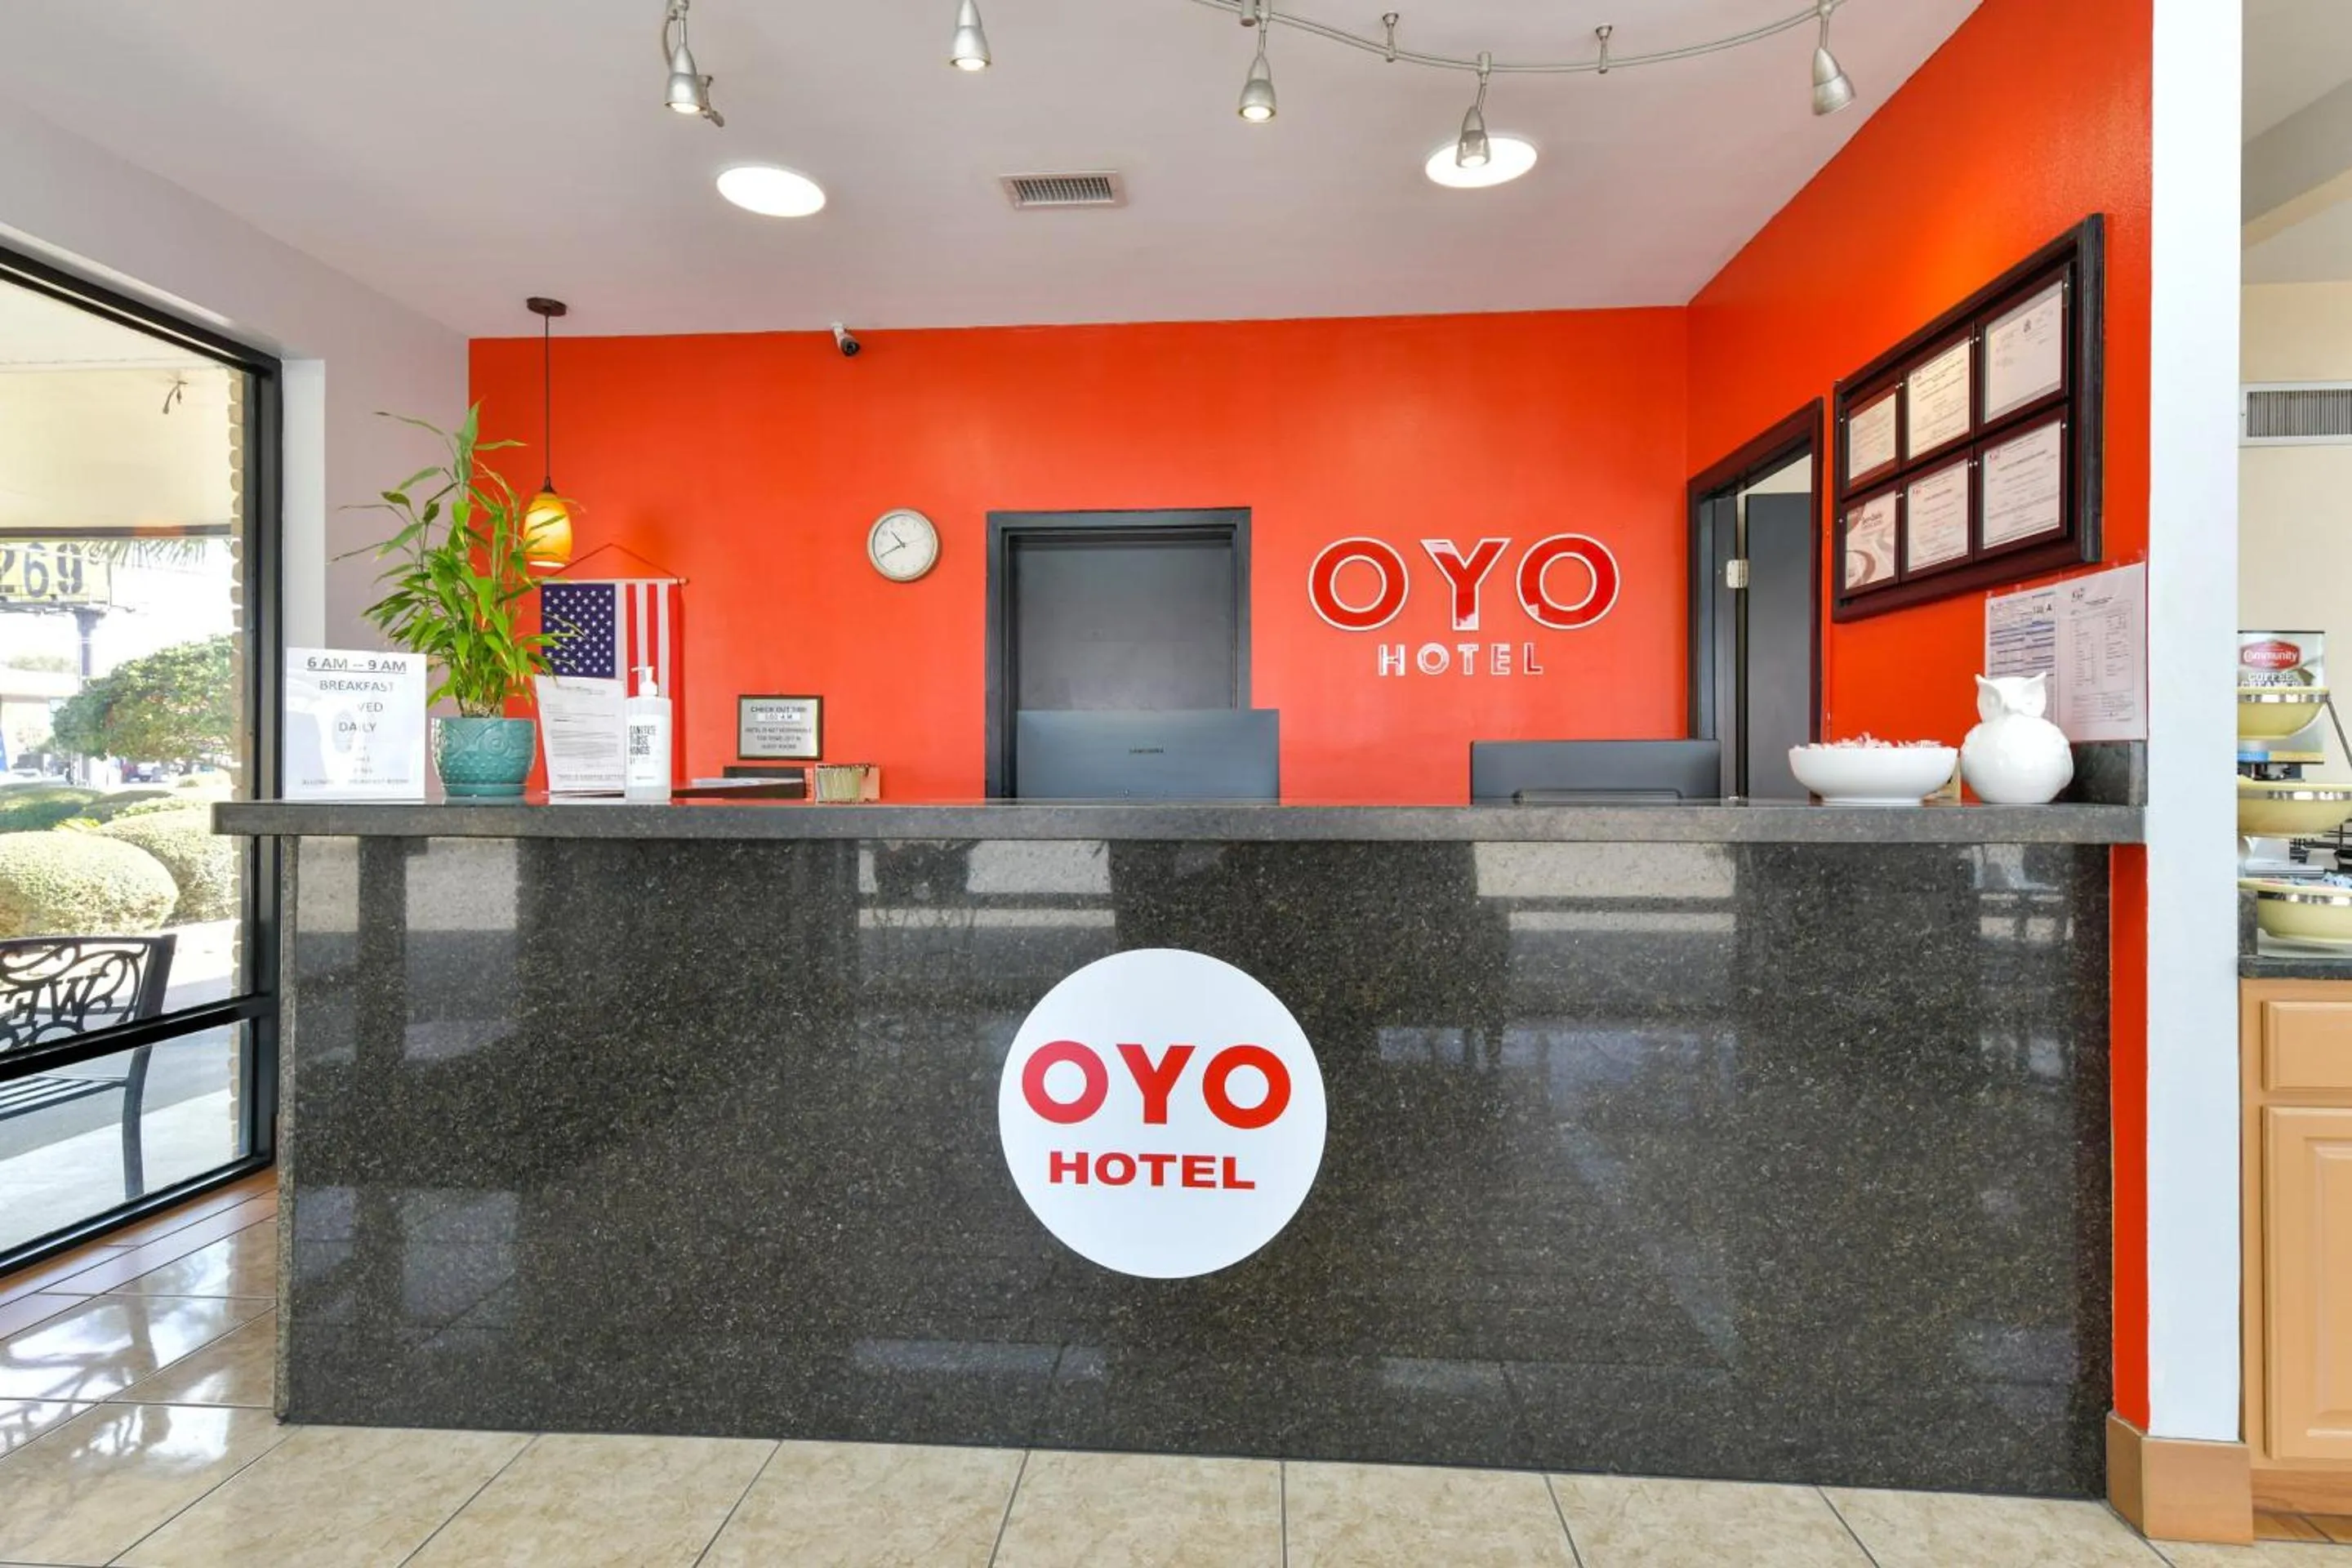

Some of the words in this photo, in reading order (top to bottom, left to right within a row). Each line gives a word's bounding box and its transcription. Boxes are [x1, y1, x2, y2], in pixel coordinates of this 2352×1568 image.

[1308, 532, 1619, 631] OYO
[306, 657, 318, 669] 6
[321, 658, 348, 670] AM
[368, 659, 377, 670] 9
[381, 661, 408, 672] AM
[1378, 642, 1544, 676] HOTEL
[2243, 649, 2299, 663] Community
[318, 679, 394, 692] BREAKFAST
[338, 721, 377, 733] DAILY
[1022, 1040, 1292, 1129] OYO
[1049, 1151, 1256, 1190] HOTEL
